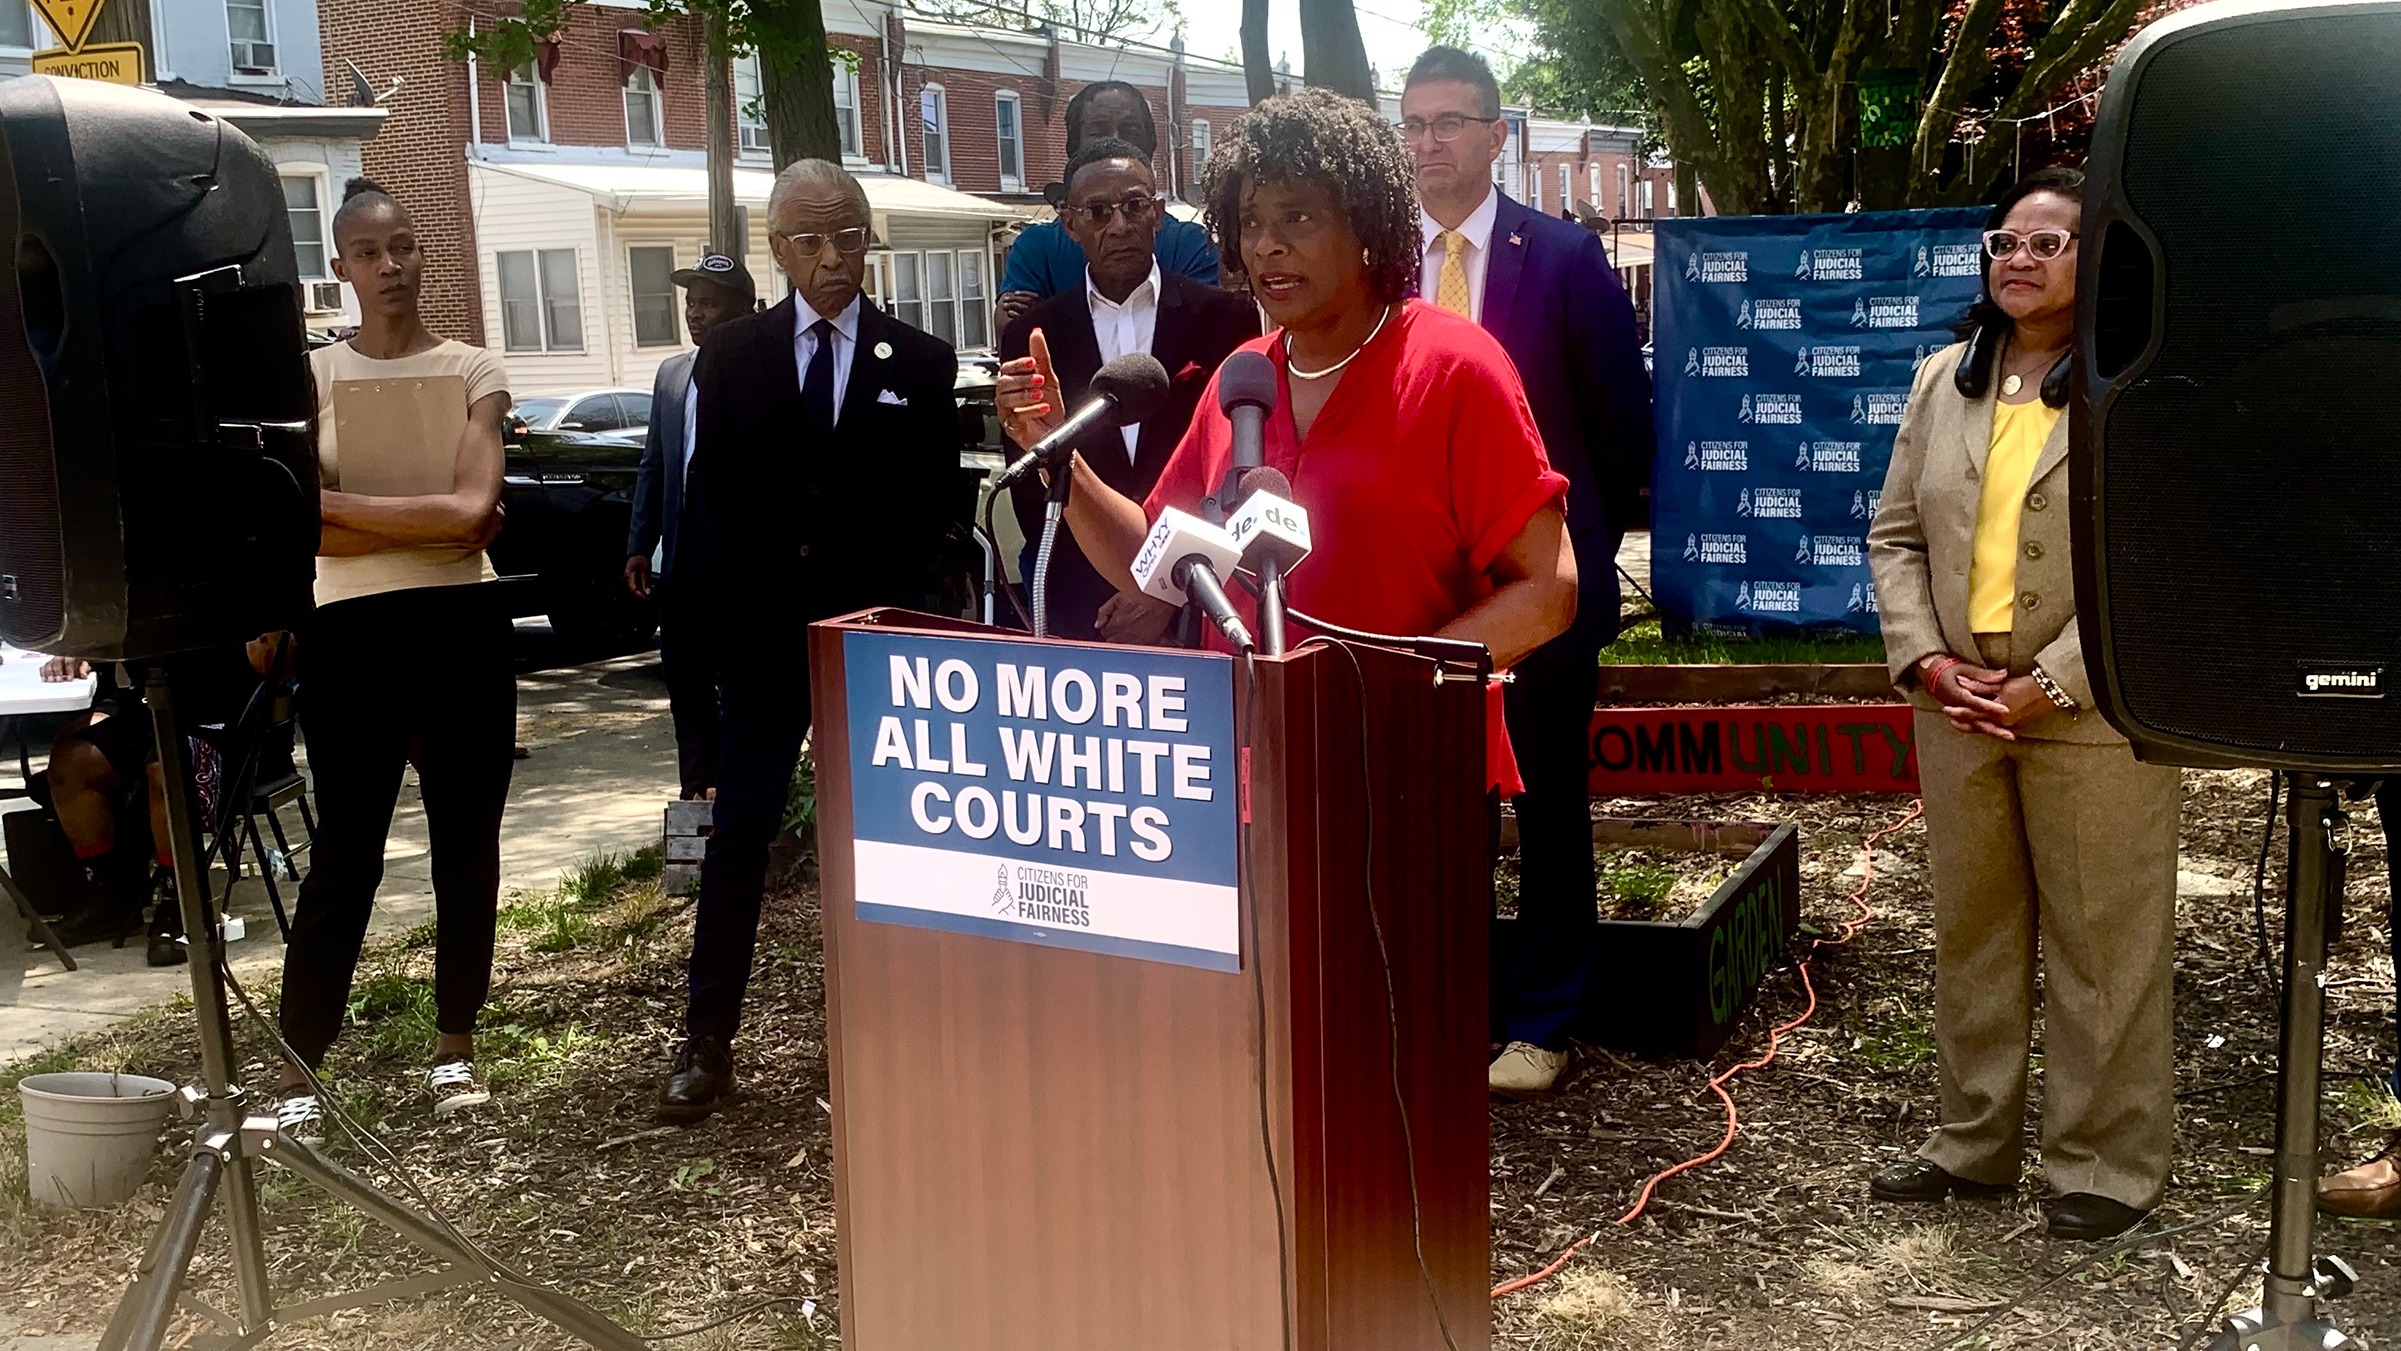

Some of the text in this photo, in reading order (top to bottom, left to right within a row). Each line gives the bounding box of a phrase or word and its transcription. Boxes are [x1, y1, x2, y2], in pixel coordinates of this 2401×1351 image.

[1813, 248, 1862, 258] CITIZENS FOR
[1933, 246, 1967, 254] CITIZENS
[1703, 252, 1748, 261] CITIZENS FOR
[1933, 253, 1980, 266] JUDICIAL
[1703, 261, 1748, 272] JUDICIAL
[1813, 258, 1862, 270] JUDICIAL
[1813, 270, 1862, 280] FAIRNESS
[1933, 264, 1981, 276] FAIRNESS
[1702, 272, 1748, 283] FAIRNESS
[1754, 299, 1800, 308] CITIZENS FOR
[1870, 296, 1919, 306] CITIZENS FOR
[1755, 308, 1801, 319] JUDICIAL
[1870, 305, 1918, 317] JUDICIAL
[1754, 319, 1801, 330] FAIRNESS
[1869, 316, 1918, 328] FAIRNESS
[1702, 347, 1748, 355] CITIZENS FOR
[1812, 346, 1860, 355] CITIZENS FOR
[1703, 355, 1748, 367] JUDICIAL
[1812, 355, 1860, 367] JUDICIAL
[1702, 367, 1749, 377] FAIRNESS
[1812, 366, 1860, 377] FAIRNESS
[1755, 394, 1801, 403] CITIZENS FOR
[1867, 394, 1901, 403] CITIZENS
[1755, 403, 1802, 414] JUDICIAL
[1755, 414, 1802, 424] FAIRNESS
[1867, 414, 1903, 425] FAIRNE
[1701, 441, 1748, 450] CITIZENS FOR
[1813, 441, 1860, 450] CITIZENS FOR
[1701, 449, 1748, 461] JUDICIAL
[1813, 450, 1860, 462] JUDICIAL
[1701, 461, 1748, 471] FAIRNESS
[1813, 461, 1860, 472] FAIRNESS
[1755, 488, 1801, 497] CITIZENS FOR
[1754, 497, 1801, 508] JUDICIAL
[1754, 507, 1801, 518] FAIRNESS
[1700, 534, 1746, 543] CITIZENS FOR
[1813, 536, 1861, 545] CITIZENS FOR
[1136, 517, 1168, 573] WHYY
[1701, 542, 1746, 554] JUDICIAL
[1814, 544, 1861, 555] JUDICIAL
[1700, 553, 1746, 564] FAIRNESS
[1813, 555, 1861, 566] FAIRNESS
[1753, 581, 1800, 590] CITIZENS FOR
[1753, 590, 1800, 601] JUDICIAL
[1753, 601, 1799, 611] FAIRNESS
[2306, 671, 2376, 691] gemini
[890, 655, 1188, 732] NO MORE
[1588, 720, 1916, 777] OMMUNITY
[872, 716, 987, 777] ALL
[998, 727, 1213, 800] WHITE
[911, 781, 1172, 862] COURTS
[1017, 867, 1088, 890] CITIZENS FOR
[1018, 882, 1089, 909] JUDICIAL
[1018, 901, 1090, 927] FAIRNESS
